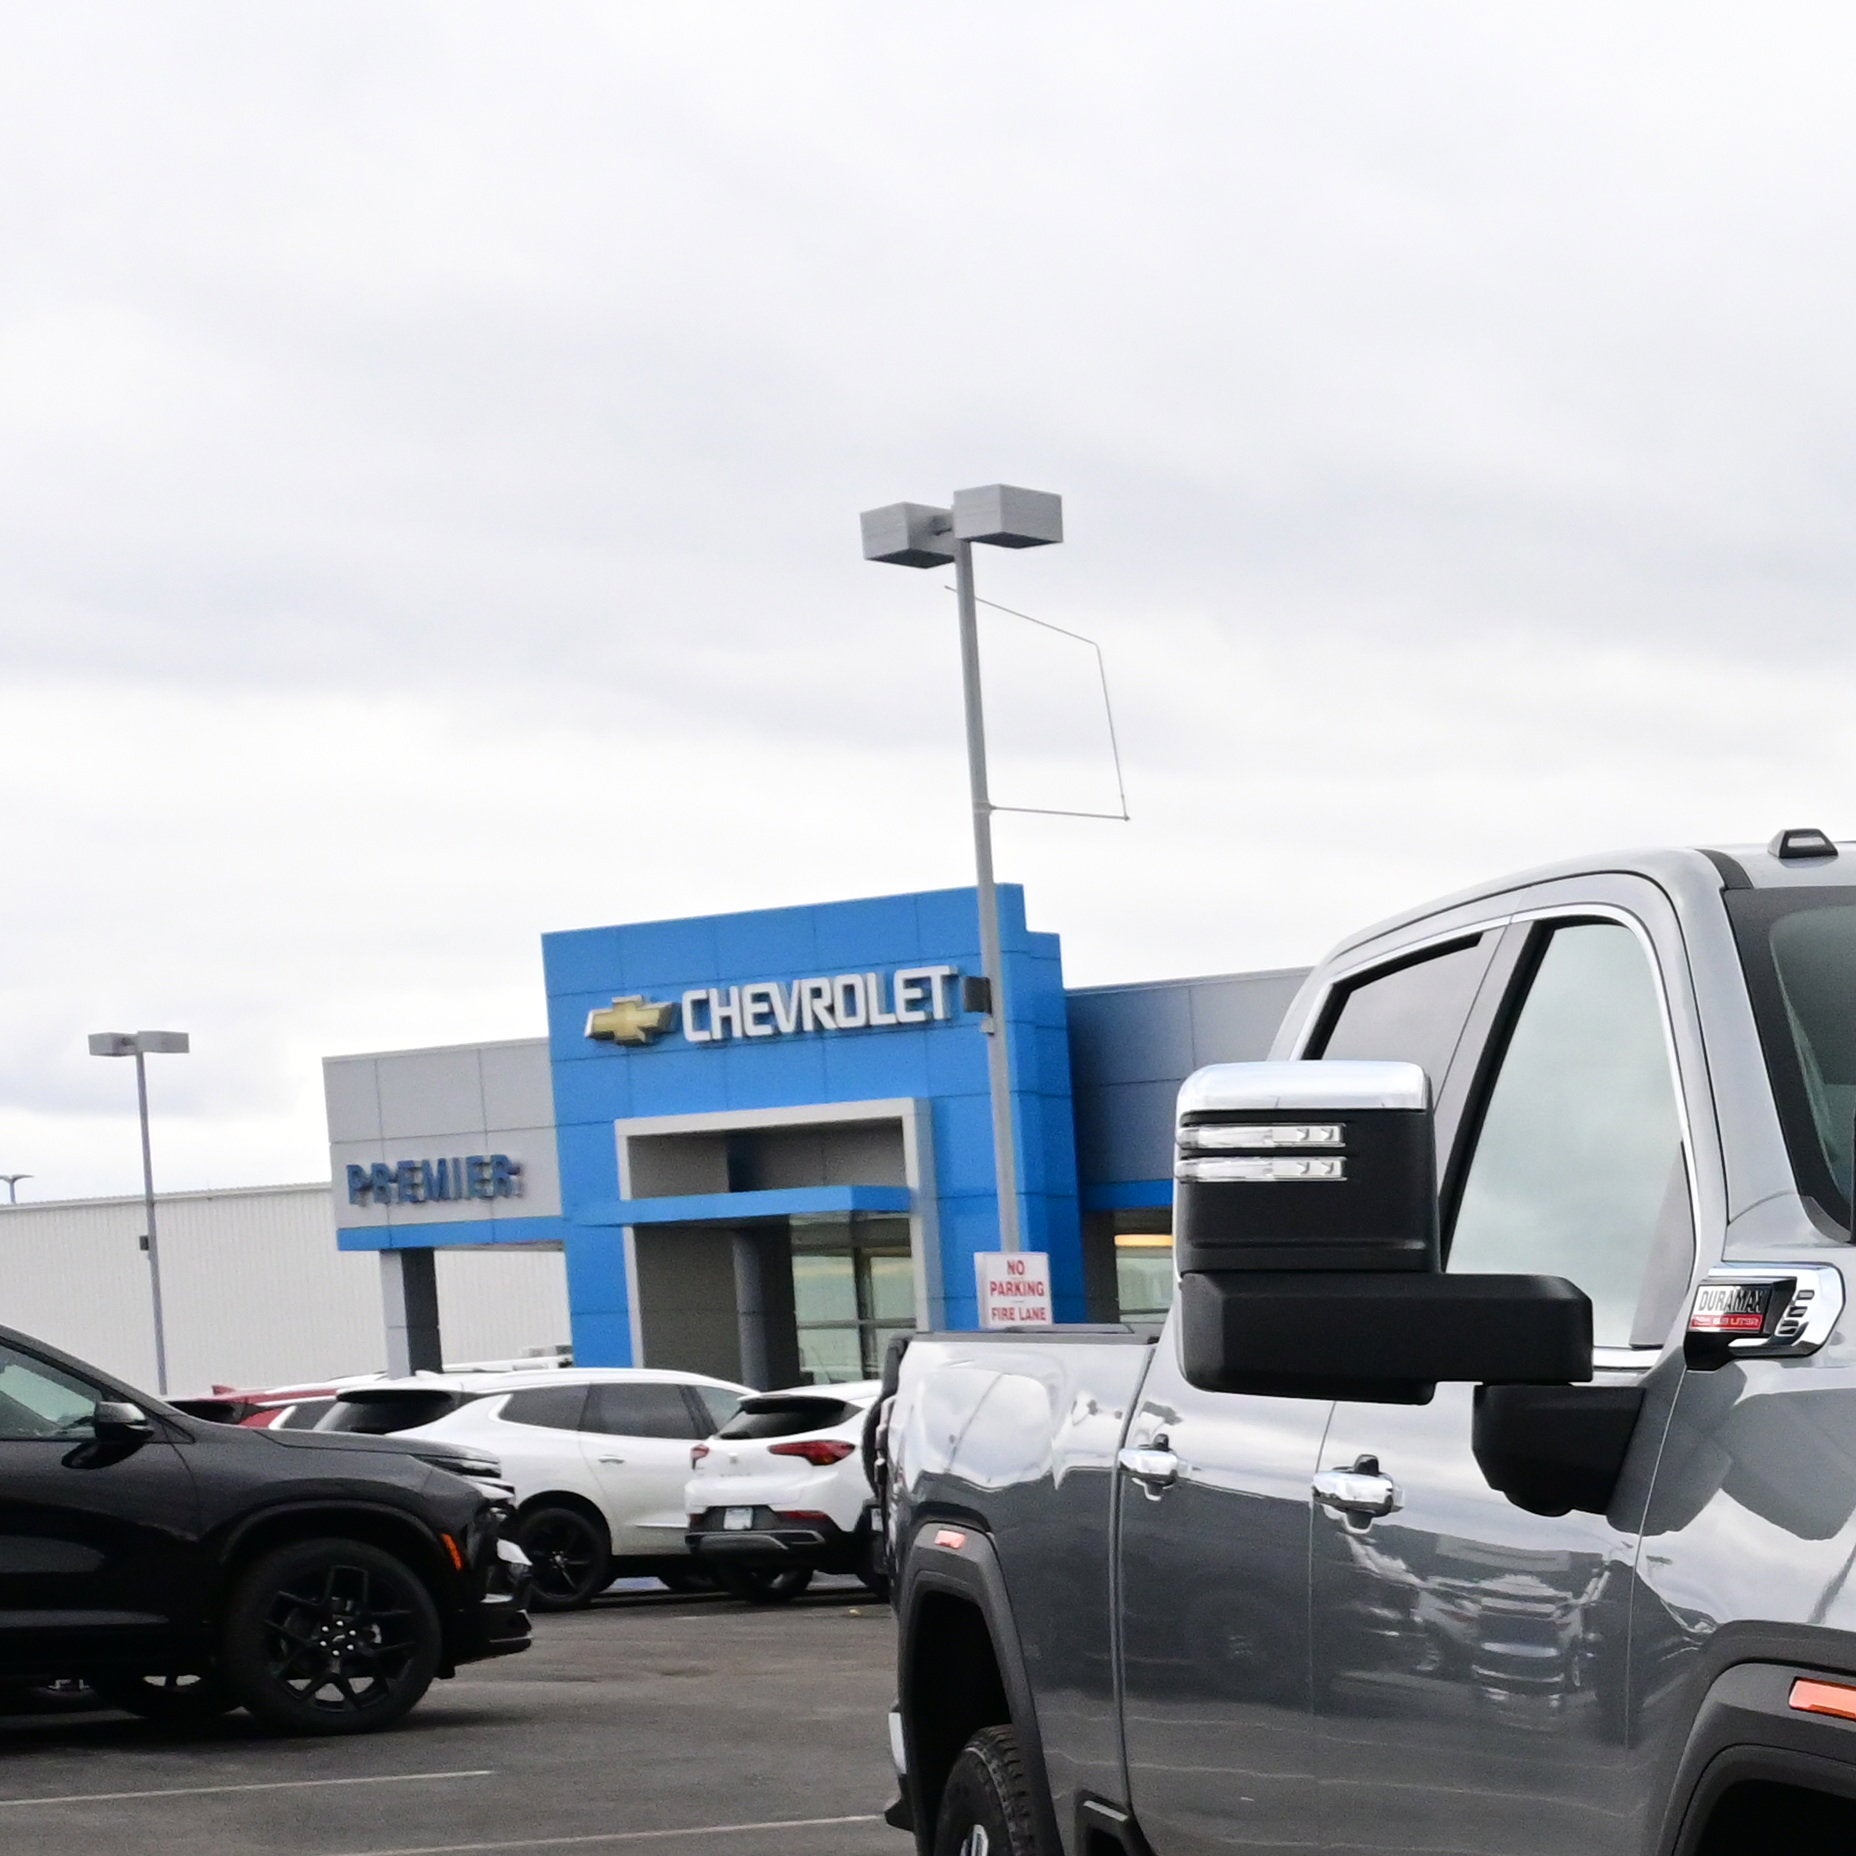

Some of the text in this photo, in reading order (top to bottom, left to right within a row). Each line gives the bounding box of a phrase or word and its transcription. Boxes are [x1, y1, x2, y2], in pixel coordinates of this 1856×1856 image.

[682, 965, 956, 1043] CHEVROLET
[346, 1154, 520, 1206] PREMIER
[1006, 1259, 1025, 1275] NO
[989, 1281, 1045, 1297] PARKING
[1698, 1289, 1764, 1313] DURAMAX
[991, 1307, 1047, 1321] FIRE LANE
